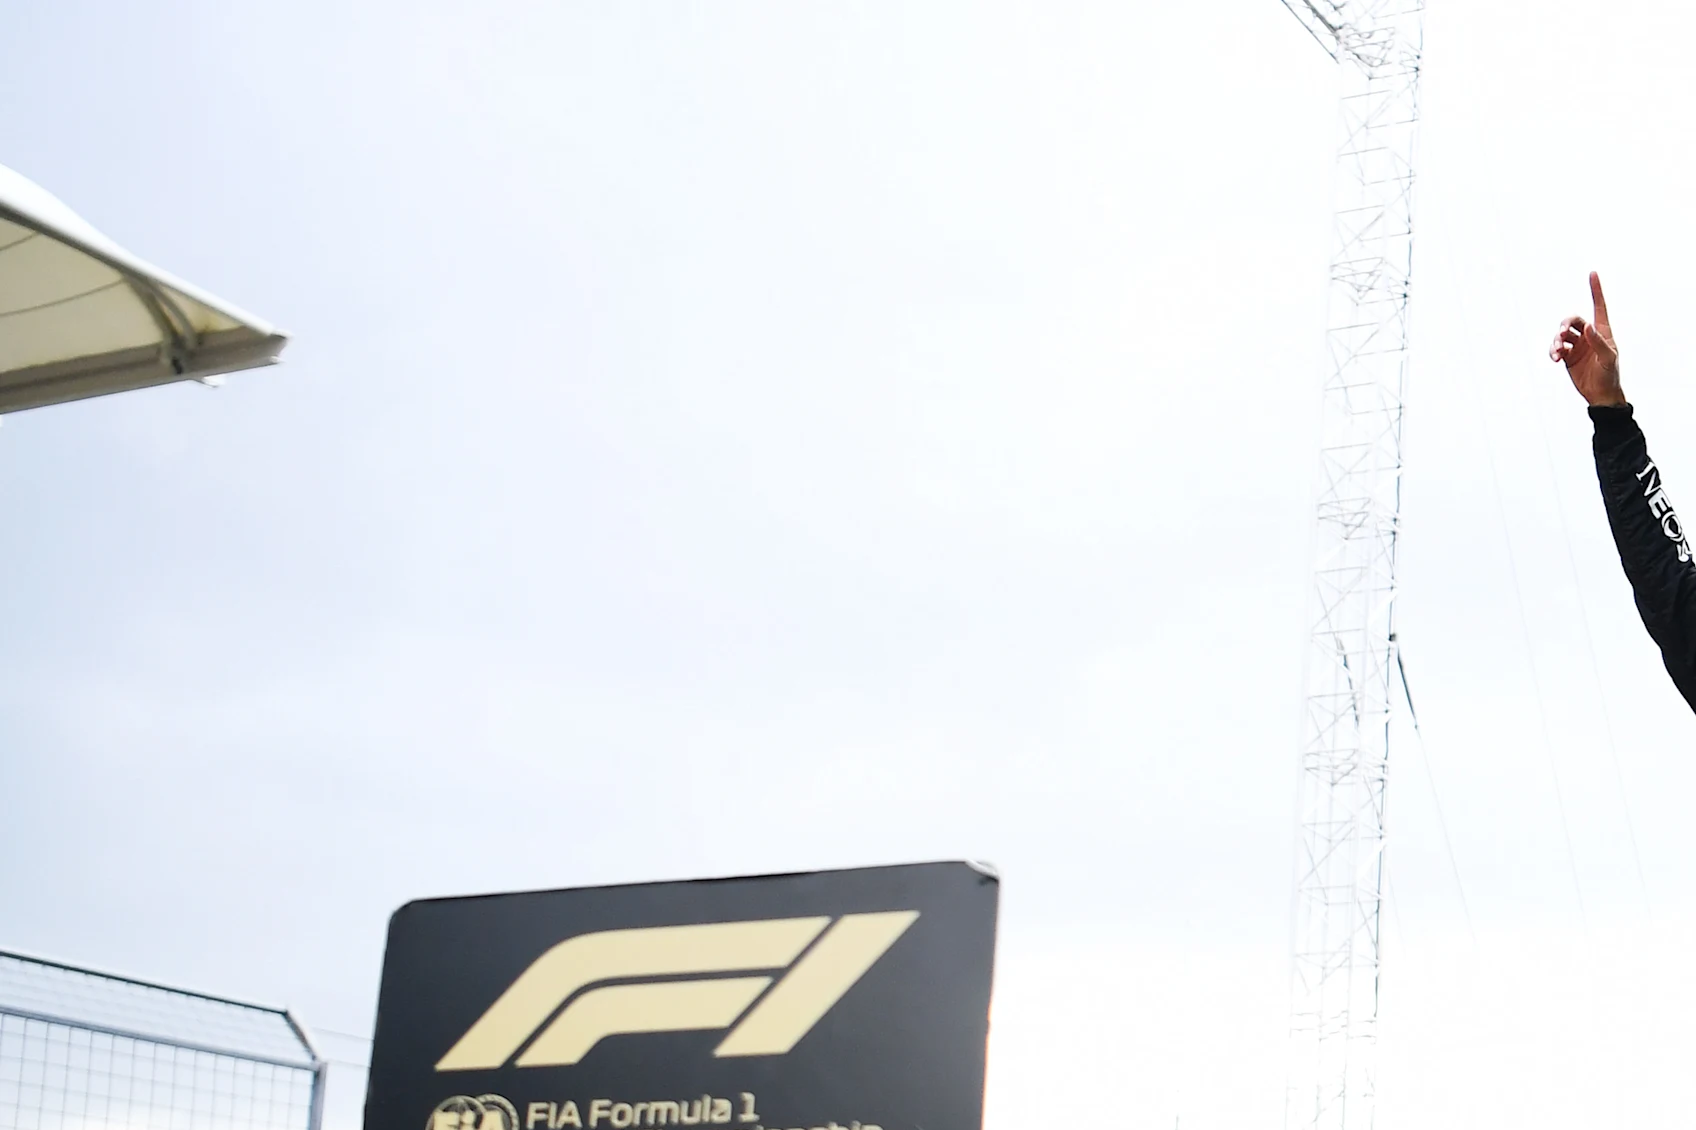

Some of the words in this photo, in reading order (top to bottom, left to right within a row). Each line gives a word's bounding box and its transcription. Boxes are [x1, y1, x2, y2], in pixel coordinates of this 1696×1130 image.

[1635, 460, 1694, 563] INEOS
[525, 1099, 580, 1130] FIA
[589, 1094, 735, 1128] Formula
[740, 1092, 758, 1121] 1
